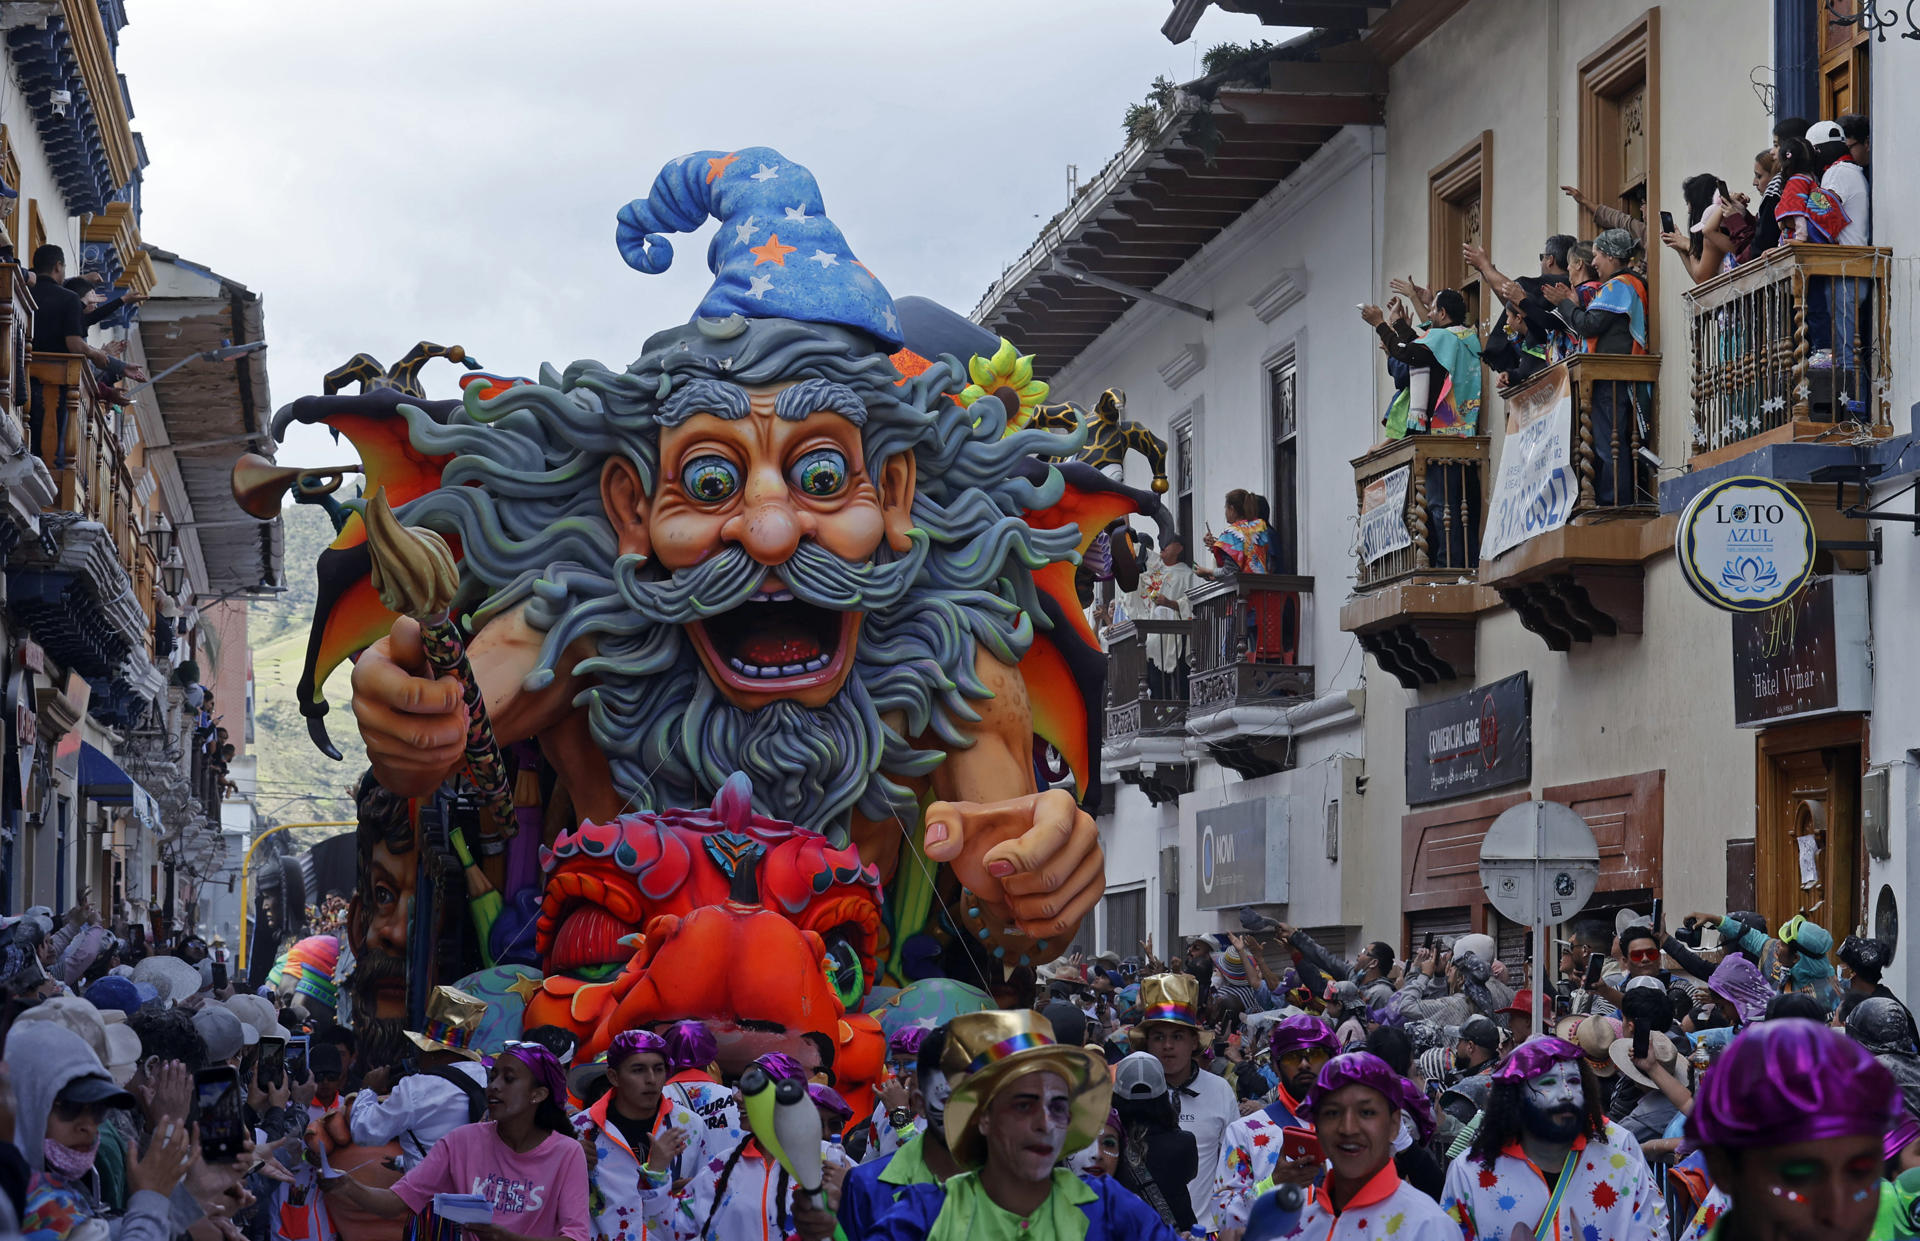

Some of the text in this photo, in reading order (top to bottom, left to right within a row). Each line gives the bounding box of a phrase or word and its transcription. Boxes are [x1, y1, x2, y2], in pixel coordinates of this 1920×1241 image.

[1716, 504, 1784, 525] LOTO
[1727, 528, 1774, 543] AZUL
[1754, 667, 1815, 698] Hotel Vymar
[1429, 723, 1464, 754] COMERCIAL
[1465, 718, 1480, 745] G&G
[487, 1172, 520, 1190] Keep
